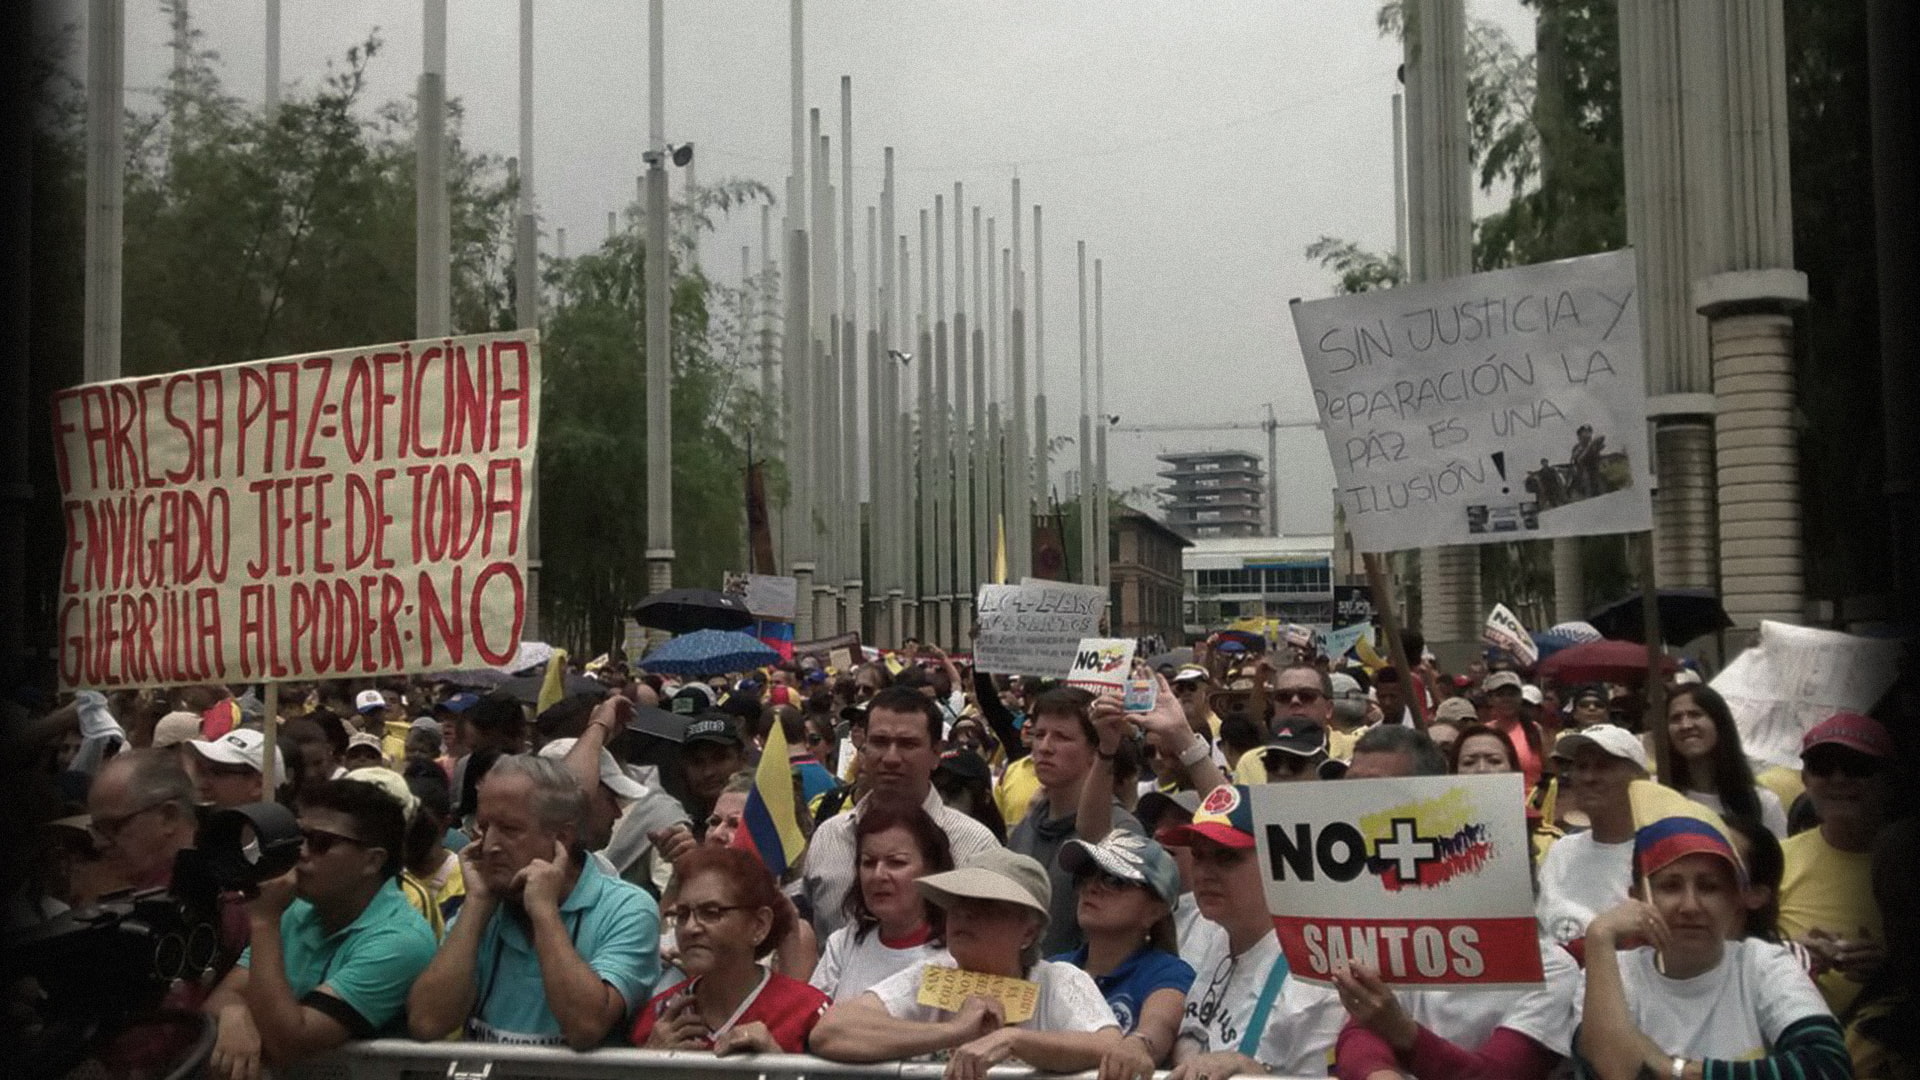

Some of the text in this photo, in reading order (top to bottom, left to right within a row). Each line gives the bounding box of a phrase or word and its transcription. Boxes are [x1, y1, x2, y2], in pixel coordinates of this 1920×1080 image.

[1319, 289, 1633, 374] SIN JUSTICIA Y
[1561, 351, 1616, 384] LA
[1428, 417, 1469, 449] ES
[1491, 399, 1566, 437] UNA
[63, 458, 522, 594] ENVIGADO JEFE DE TODA
[60, 585, 227, 687] GUERRILLA
[1303, 924, 1485, 978] SANTOS
